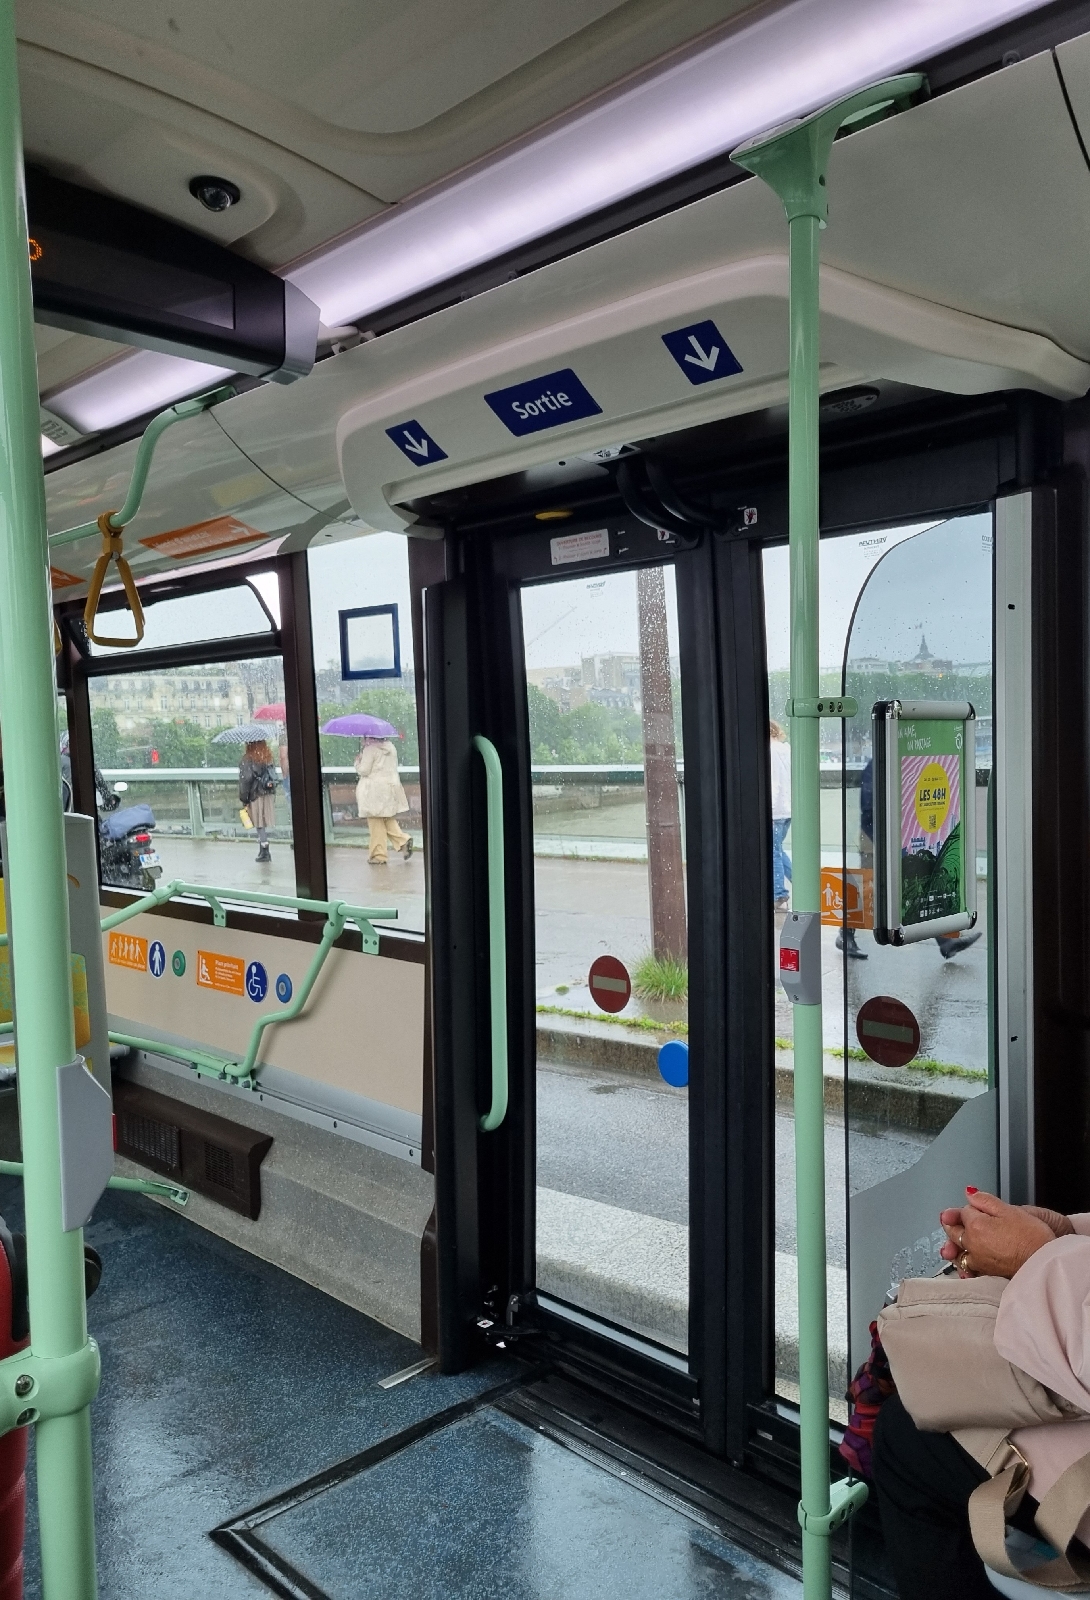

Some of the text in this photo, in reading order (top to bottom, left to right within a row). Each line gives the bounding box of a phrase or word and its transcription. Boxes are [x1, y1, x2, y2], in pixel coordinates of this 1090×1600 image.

[511, 390, 573, 420] Sortie
[919, 787, 947, 802] LES 48H
